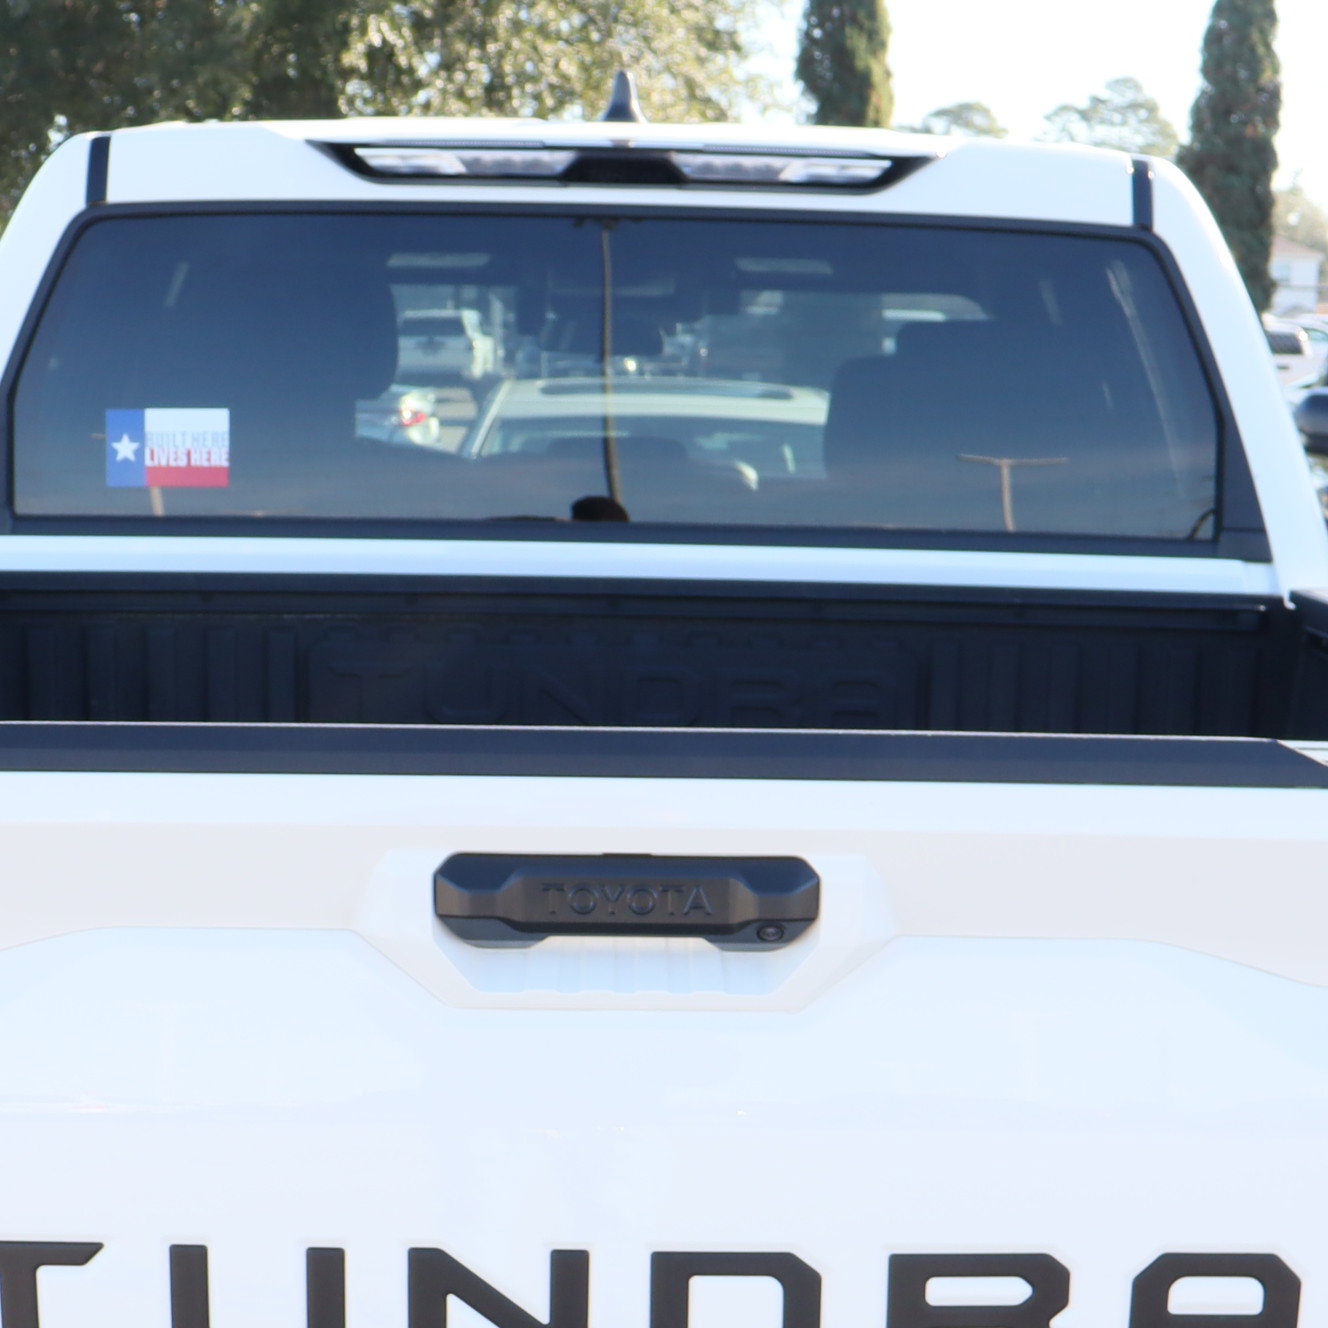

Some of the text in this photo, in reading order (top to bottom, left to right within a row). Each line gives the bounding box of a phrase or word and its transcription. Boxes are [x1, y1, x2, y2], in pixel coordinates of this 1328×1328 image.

[146, 431, 228, 448] BUILT HERE
[145, 448, 229, 467] LIVES HERE
[541, 881, 713, 916] TOYOTA
